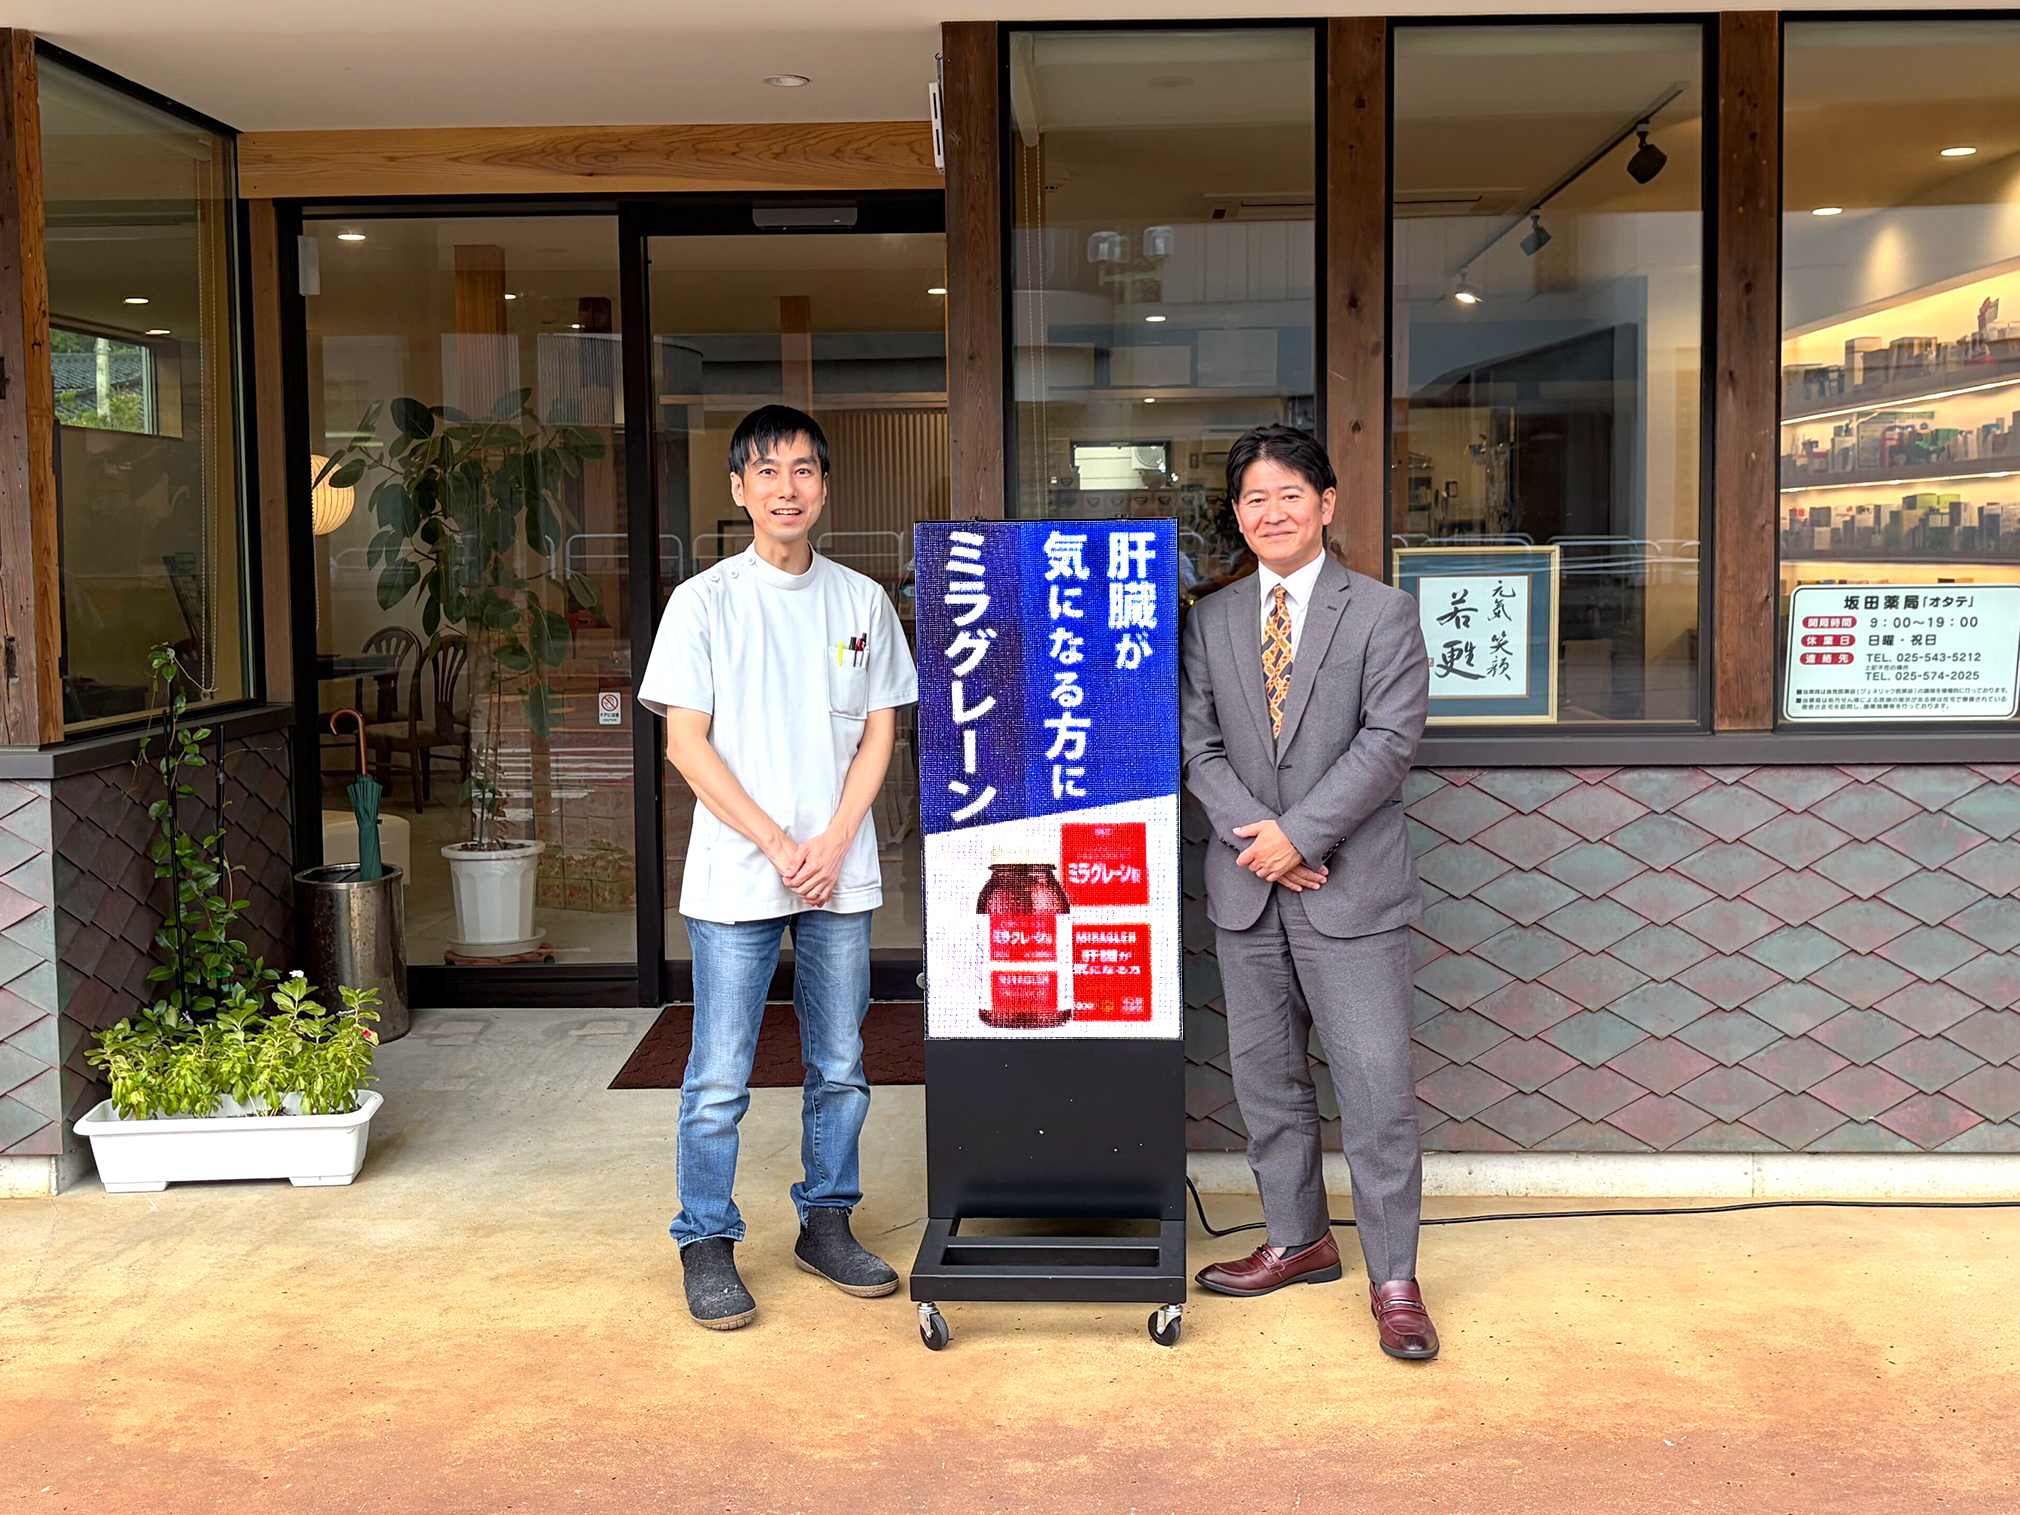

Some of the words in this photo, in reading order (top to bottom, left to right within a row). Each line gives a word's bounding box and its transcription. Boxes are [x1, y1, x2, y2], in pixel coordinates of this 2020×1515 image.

[1108, 531, 1158, 669] 肝臓が
[1487, 580, 1516, 622] 元気
[1806, 635, 1850, 646] 休業日
[1868, 634, 1937, 646] 日曜・祝日
[1805, 653, 1849, 663] 連絡先
[1867, 653, 1892, 663] TEL.
[1896, 652, 1982, 663] 025-543-5212
[1044, 531, 1091, 799] 気になる方に
[944, 531, 997, 822] ミラグレーン
[1865, 671, 1890, 681] TEL.
[1895, 671, 1980, 681] 025-574-2025
